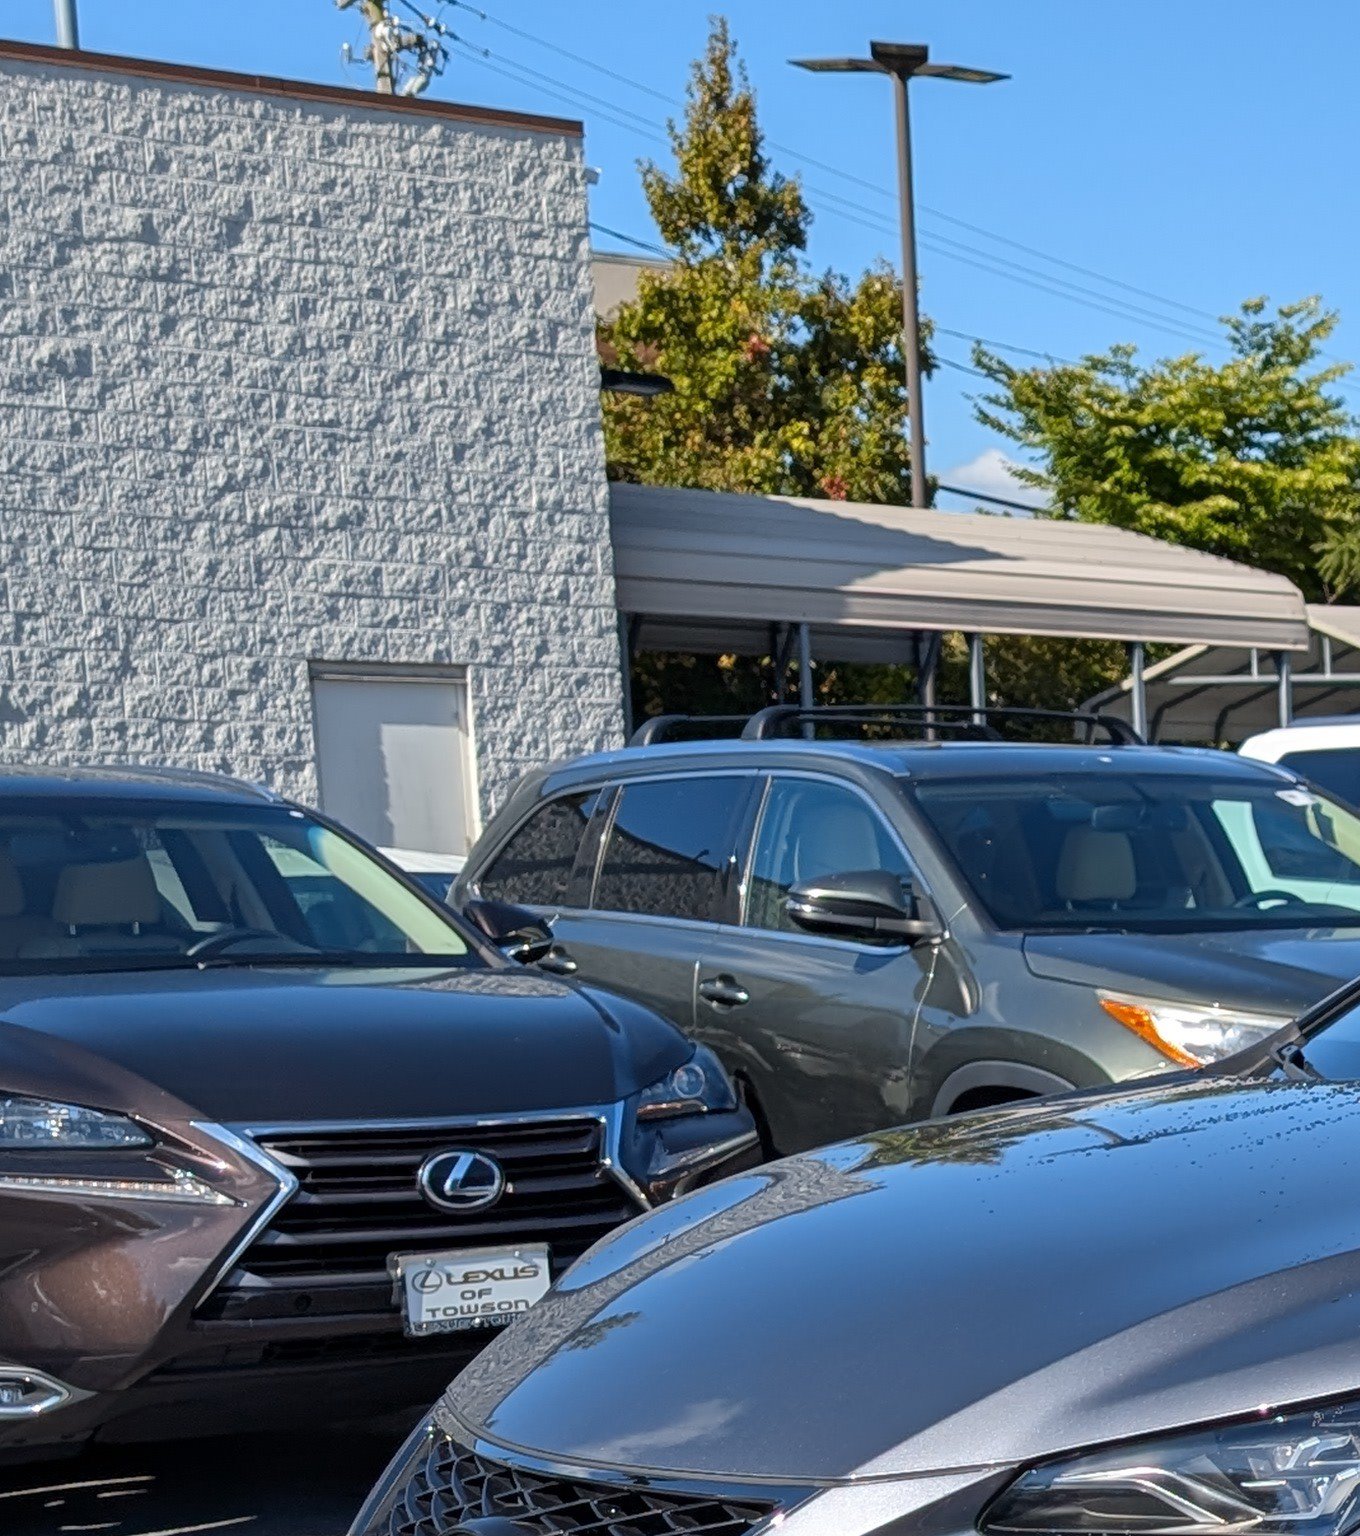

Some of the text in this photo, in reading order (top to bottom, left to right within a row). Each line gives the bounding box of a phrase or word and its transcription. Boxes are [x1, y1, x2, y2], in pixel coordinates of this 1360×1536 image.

[447, 1265, 539, 1286] LEXUS
[460, 1288, 492, 1301] OF
[426, 1300, 530, 1318] TOWSON
